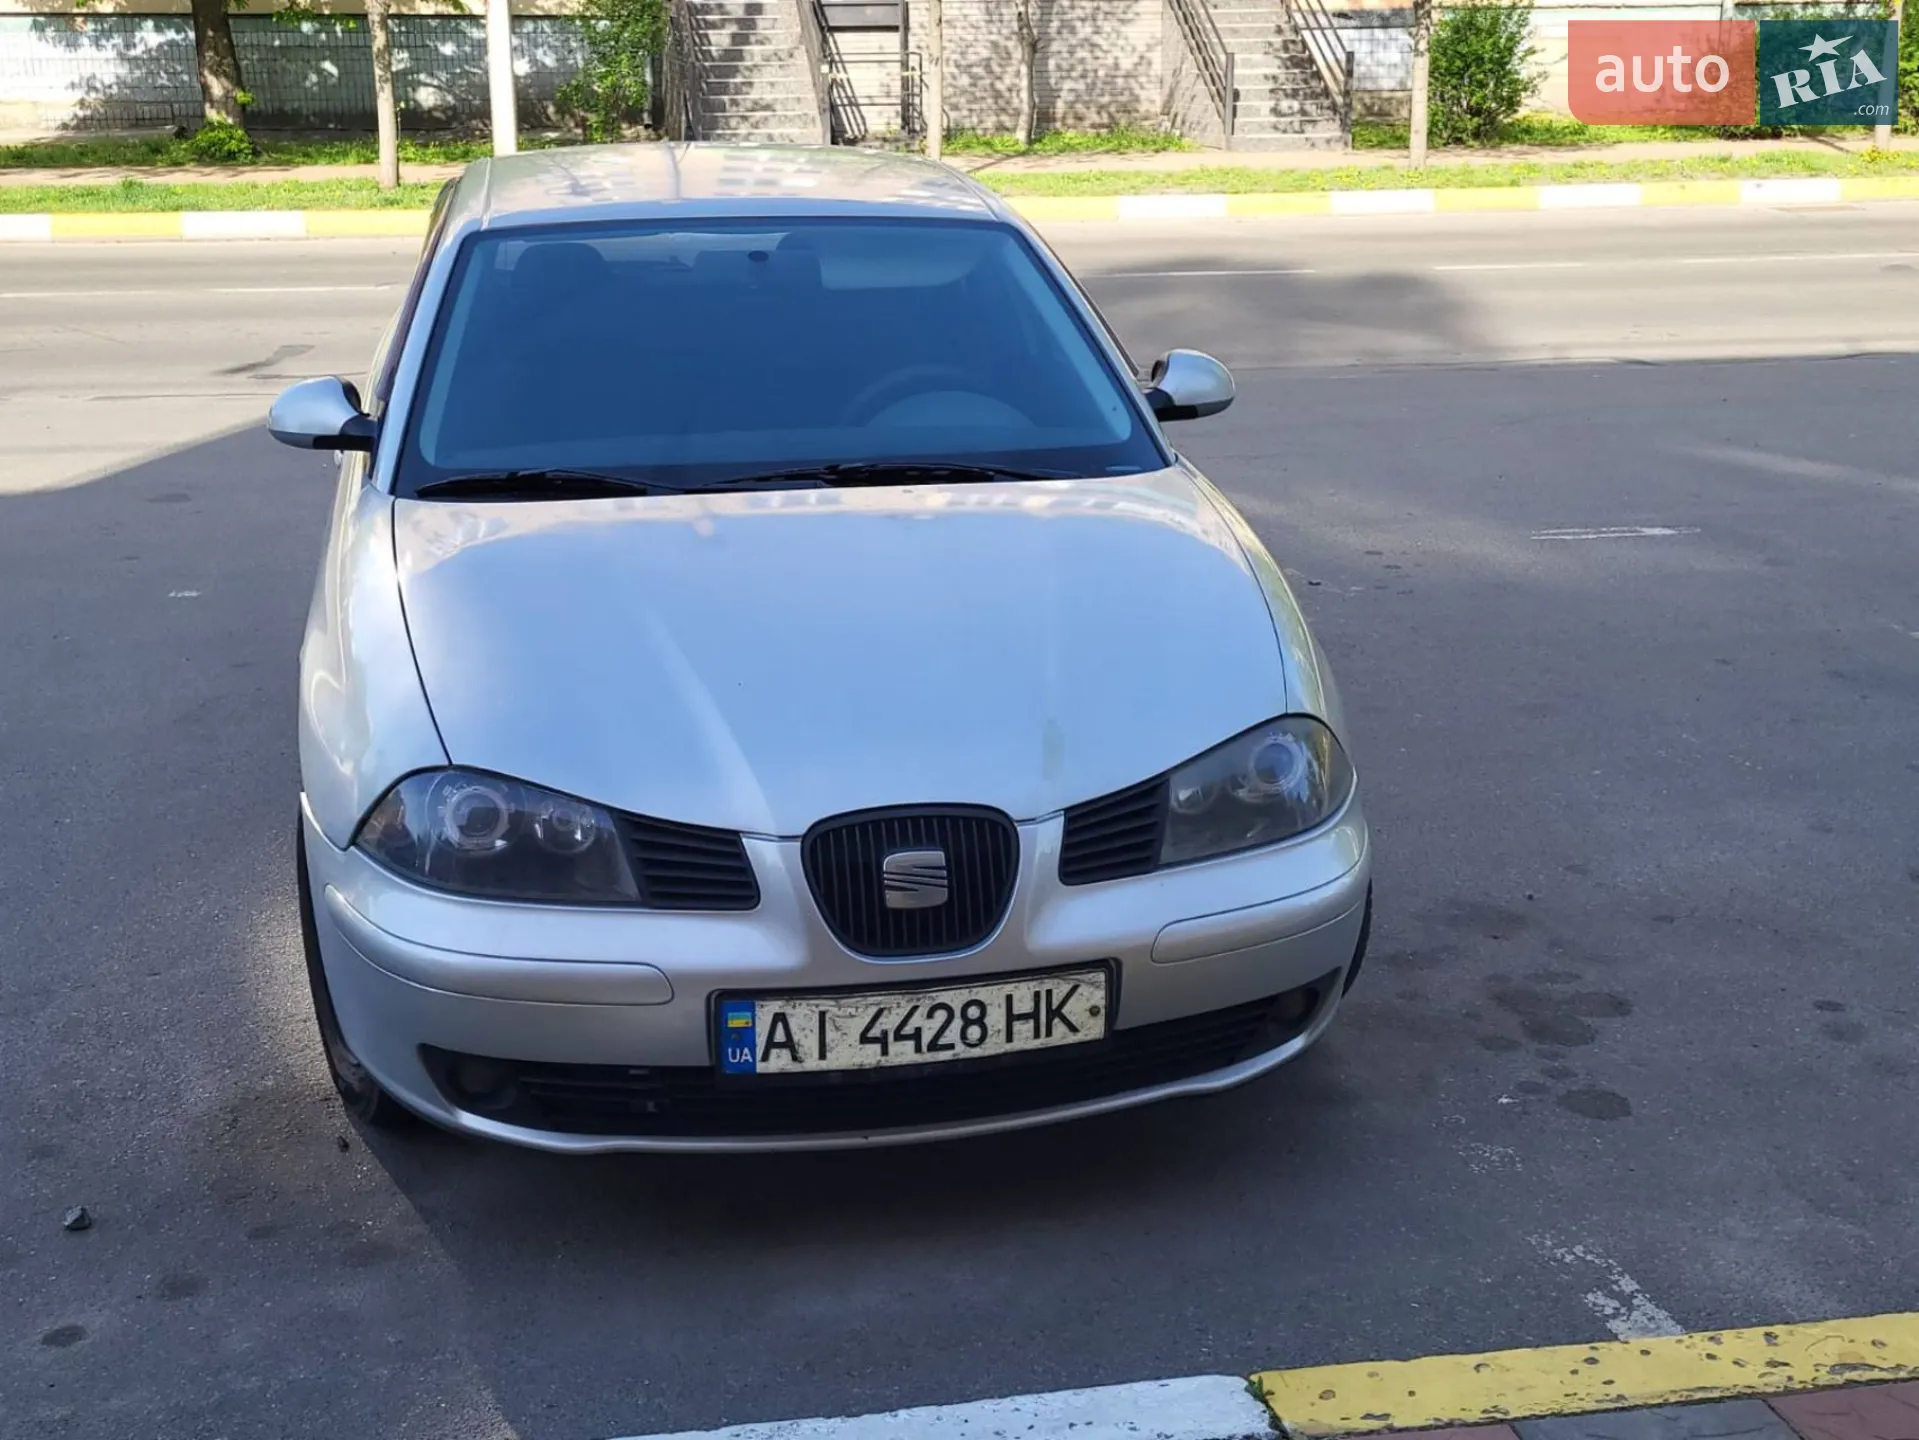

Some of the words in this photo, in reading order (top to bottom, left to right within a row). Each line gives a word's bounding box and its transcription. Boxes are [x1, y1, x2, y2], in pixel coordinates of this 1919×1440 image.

[759, 1010, 828, 1063] AI
[858, 999, 989, 1057] 4428
[1004, 984, 1081, 1044] HK
[727, 1047, 754, 1064] UA
